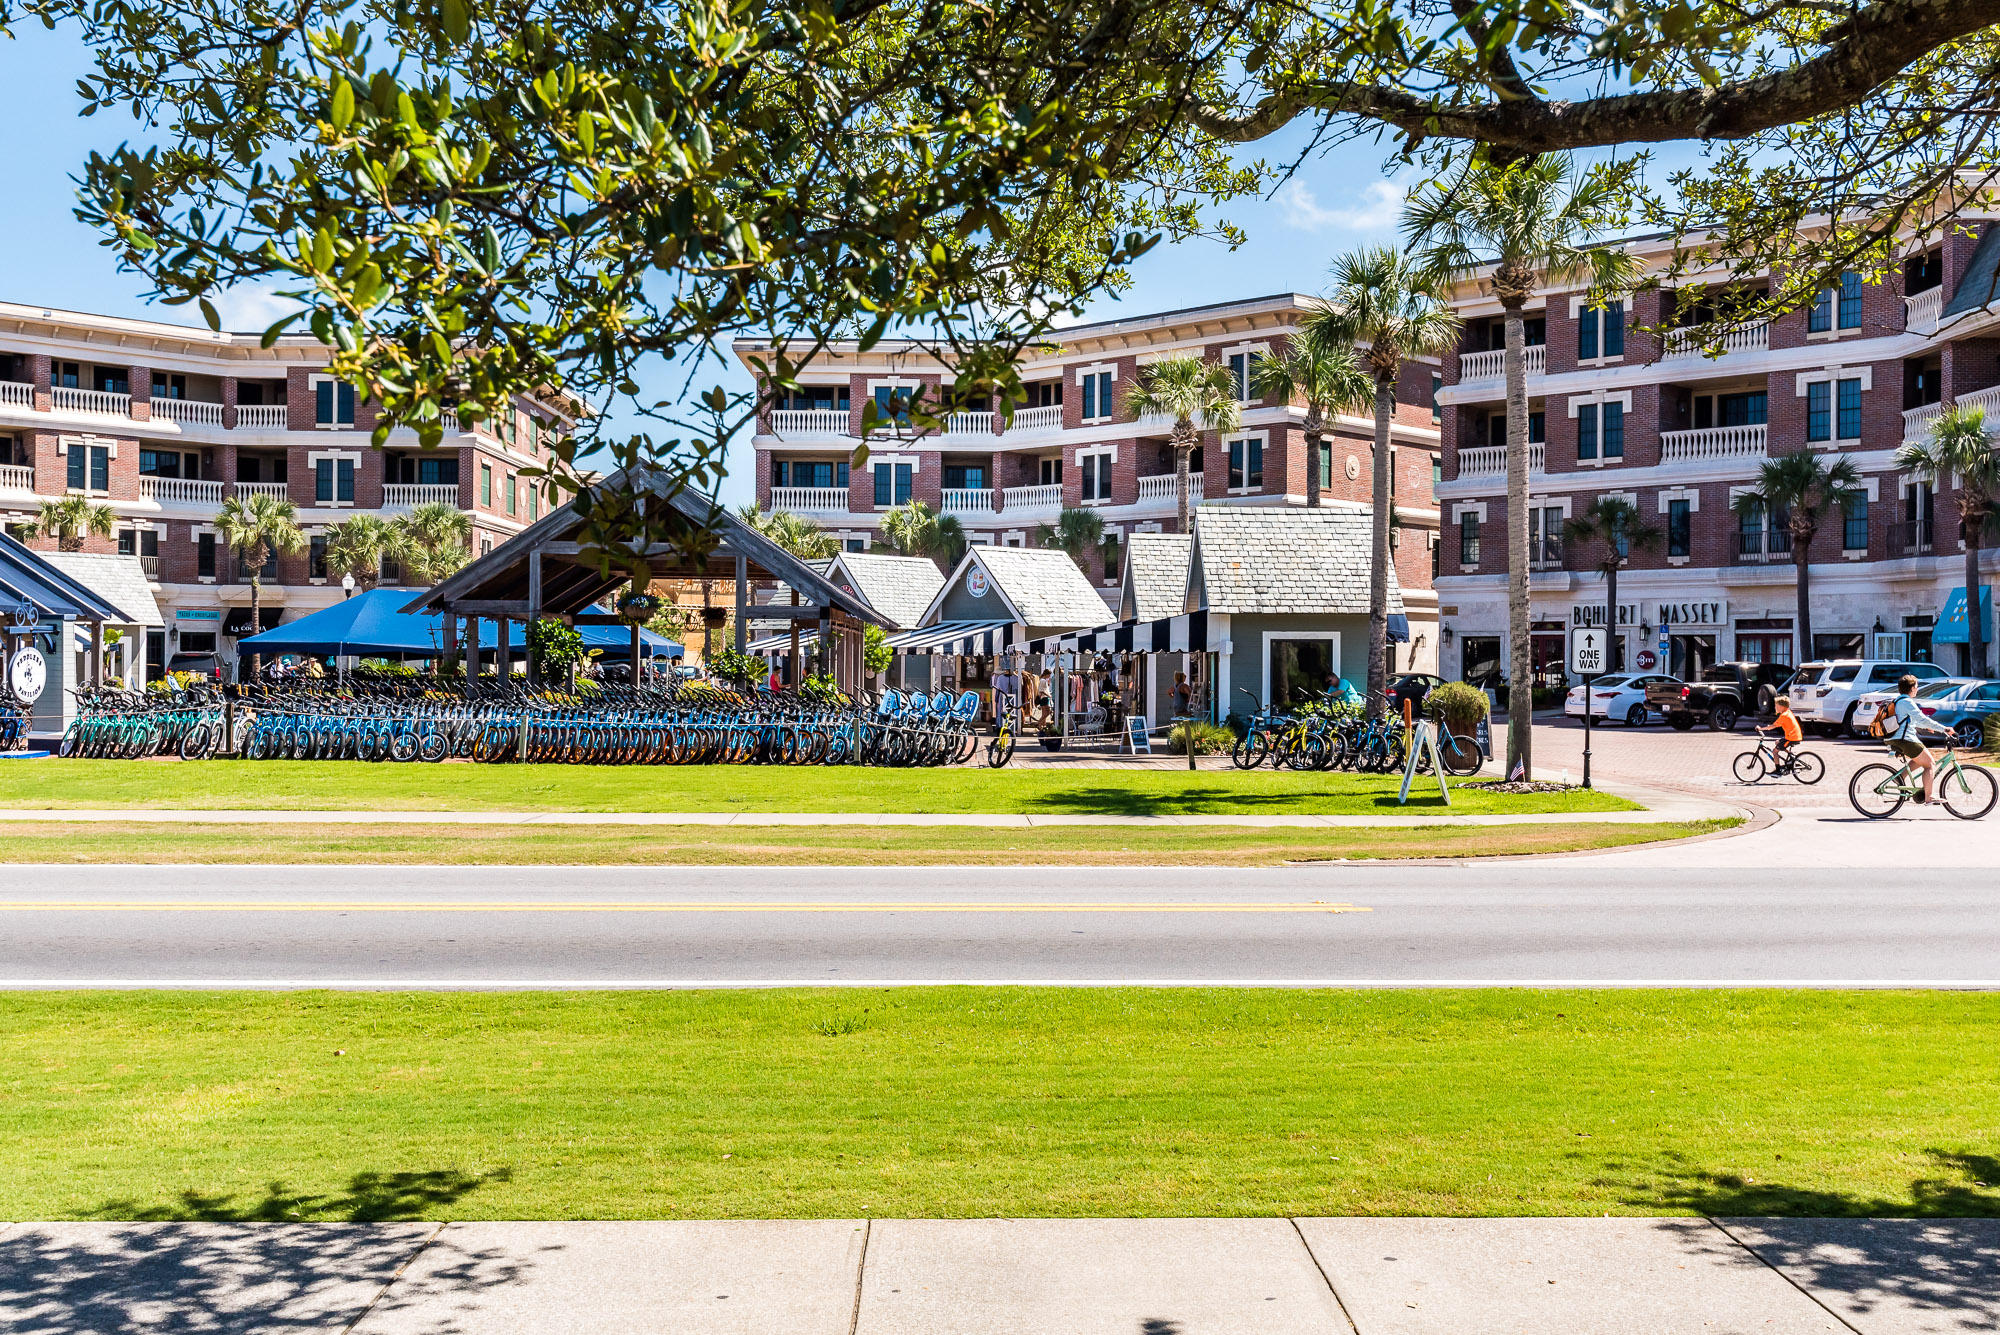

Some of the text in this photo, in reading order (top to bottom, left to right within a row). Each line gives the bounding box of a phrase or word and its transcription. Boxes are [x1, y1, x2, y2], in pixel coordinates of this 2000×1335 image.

[1573, 605, 1635, 625] BOHLRT
[1659, 603, 1719, 624] MASSEY
[1579, 649, 1600, 660] ONE
[1579, 660, 1600, 669] WAY
[19, 684, 41, 697] PAVILION
